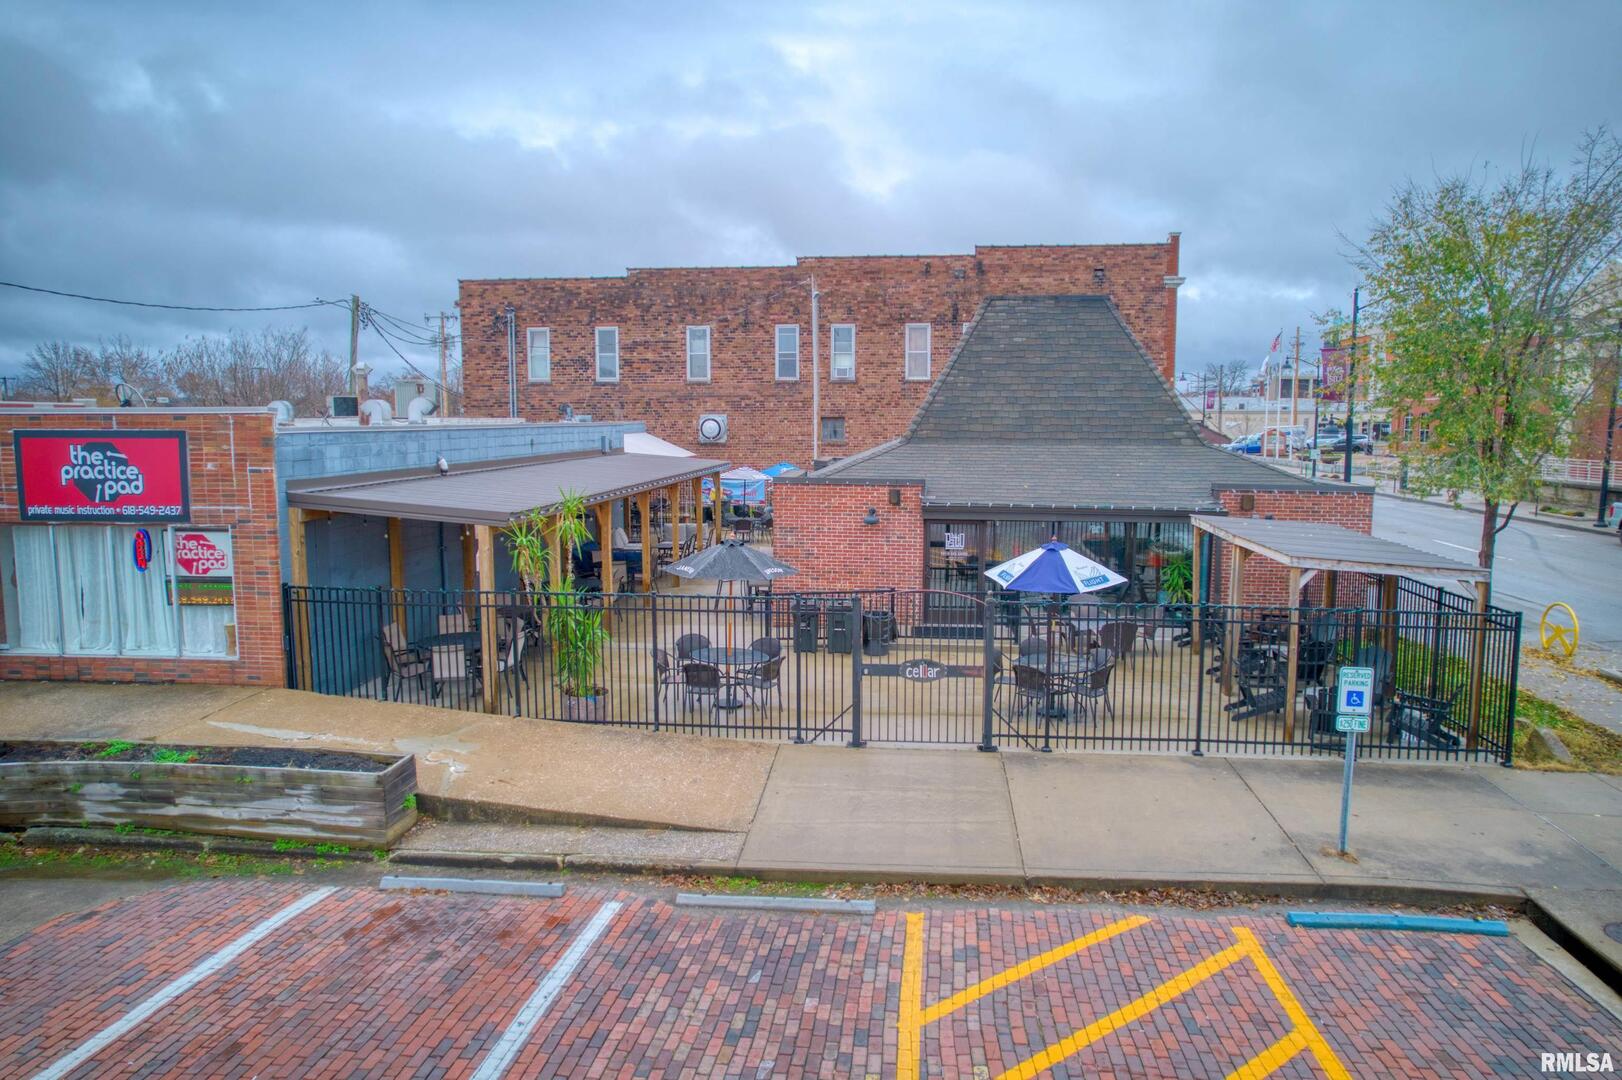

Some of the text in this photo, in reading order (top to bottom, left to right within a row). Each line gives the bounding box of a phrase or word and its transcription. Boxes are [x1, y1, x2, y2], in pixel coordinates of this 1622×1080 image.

[69, 444, 104, 465] the
[60, 460, 139, 486] practice
[104, 474, 144, 501] pad
[27, 505, 182, 516] private music instruction 618-549-2437
[177, 545, 223, 559] ractice
[198, 554, 228, 574] pad
[905, 664, 941, 679] cellar
[1343, 679, 1369, 687] PARKING
